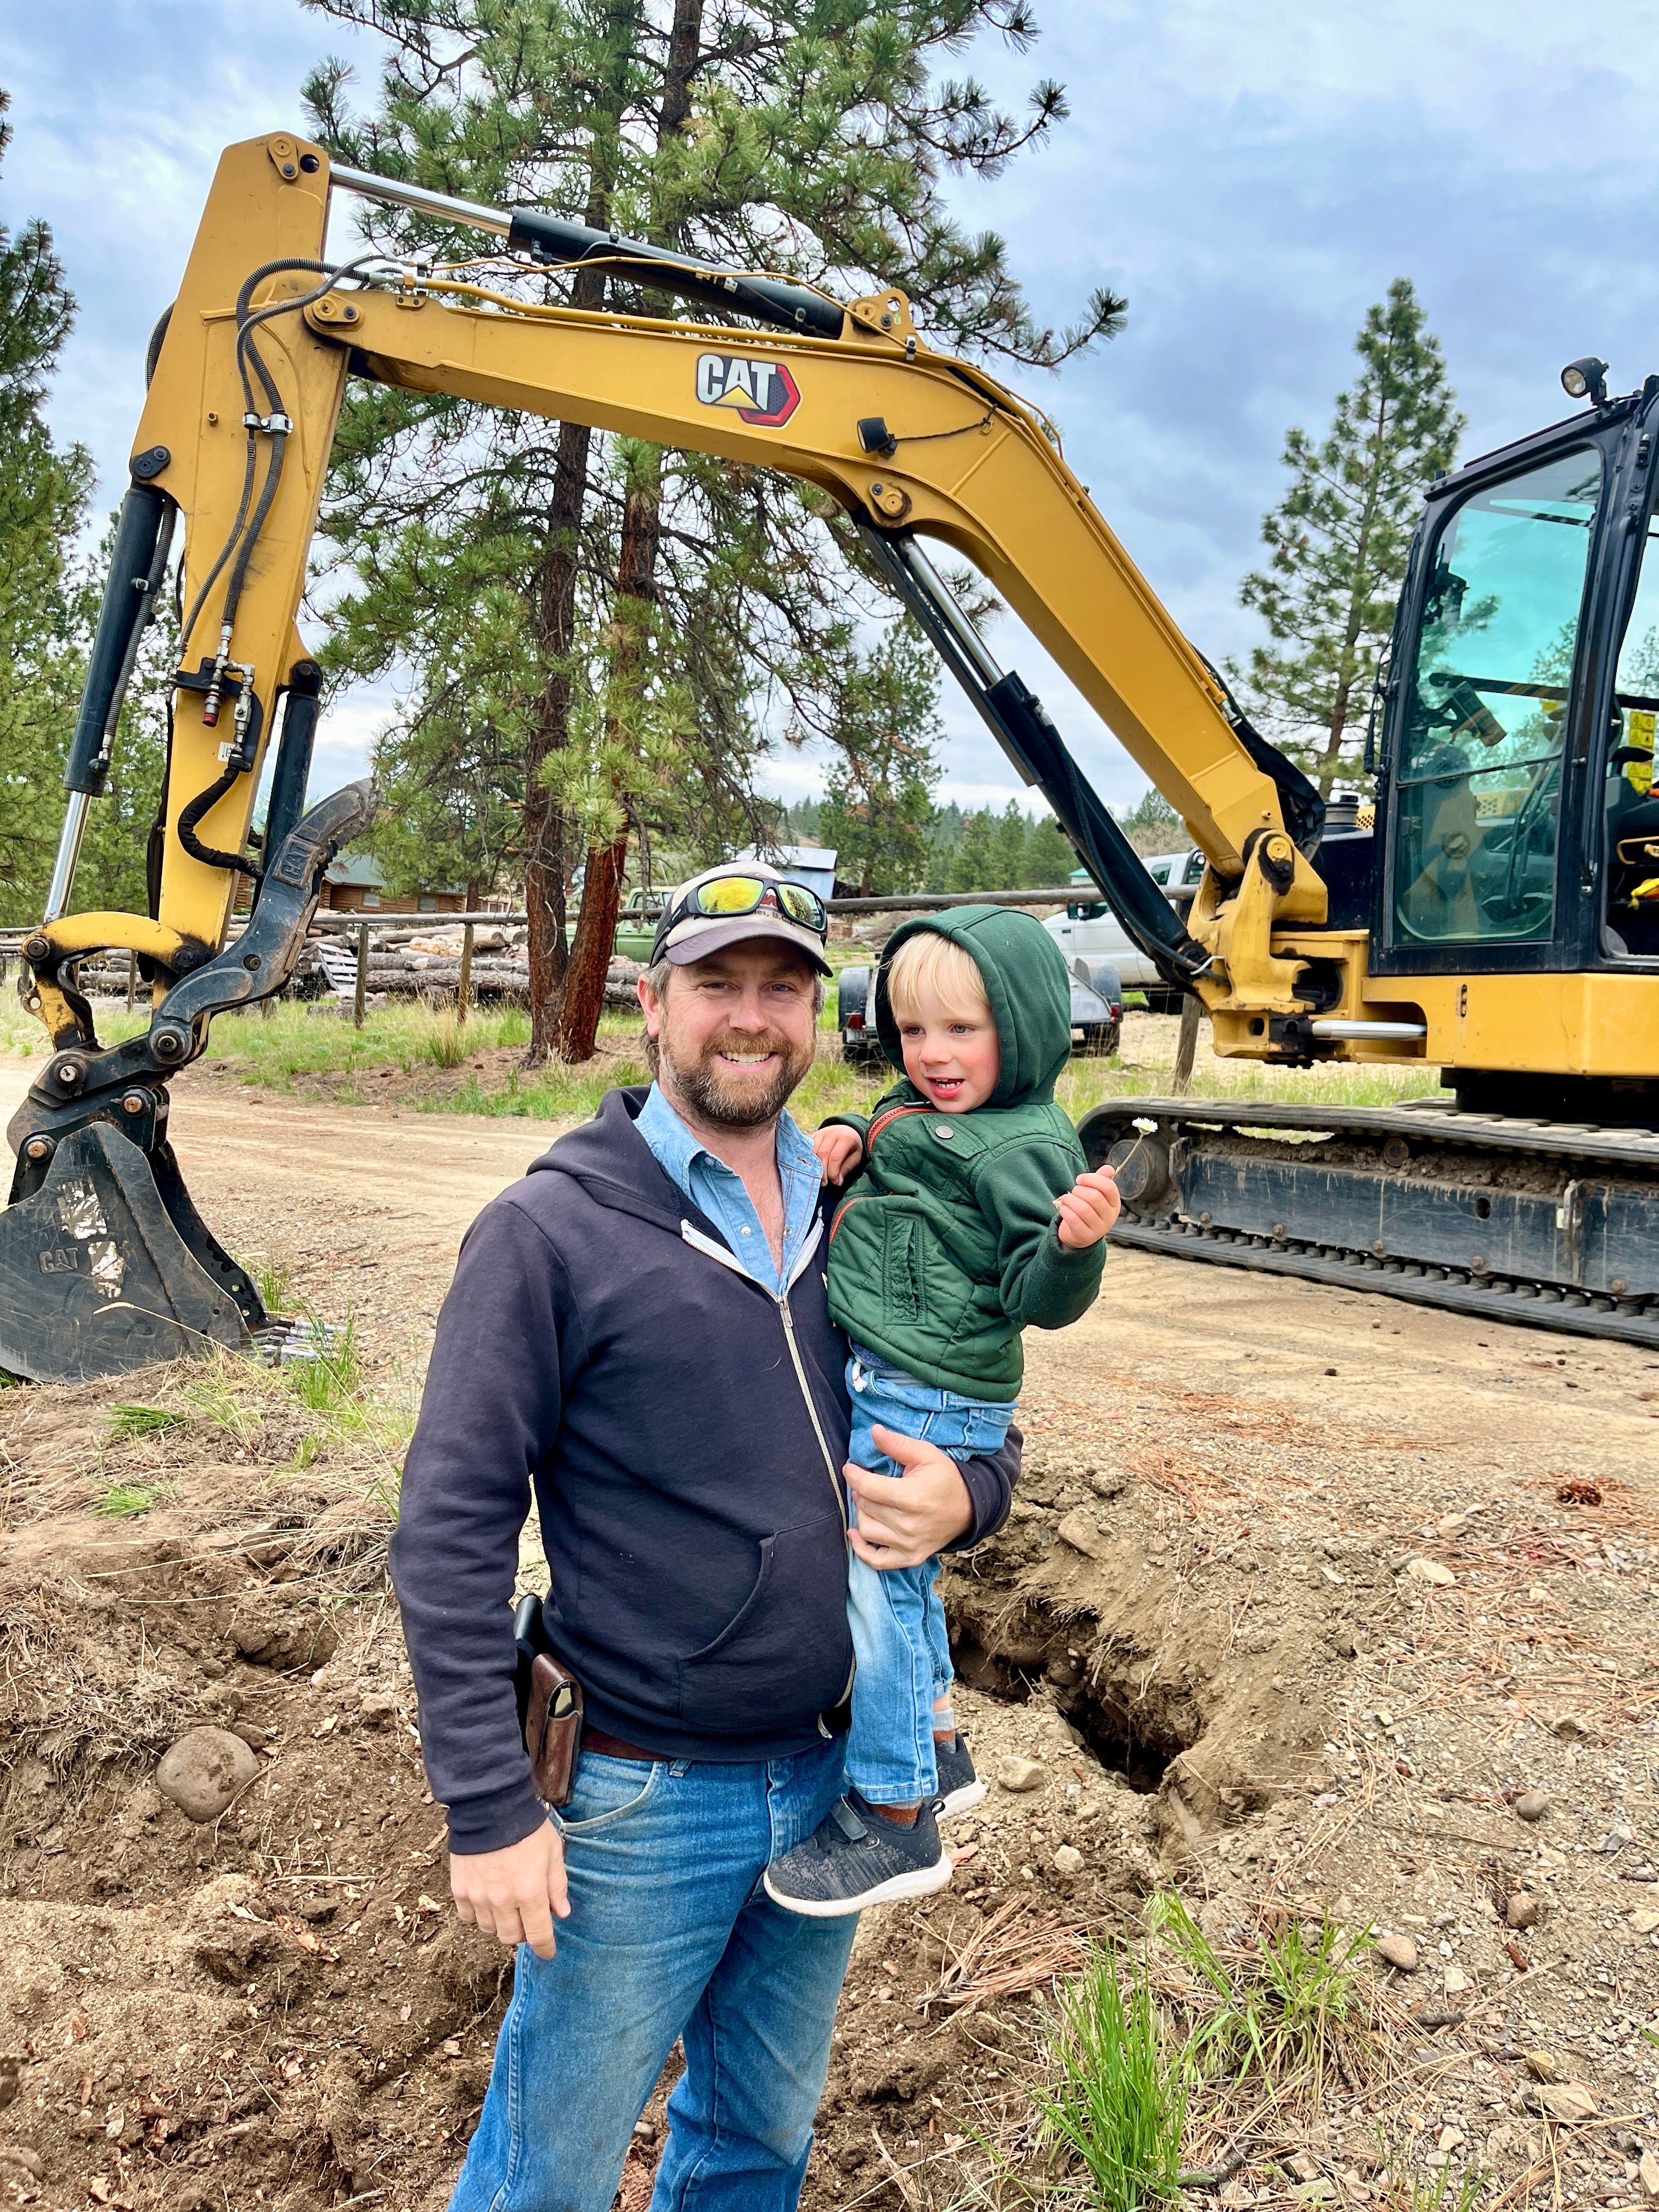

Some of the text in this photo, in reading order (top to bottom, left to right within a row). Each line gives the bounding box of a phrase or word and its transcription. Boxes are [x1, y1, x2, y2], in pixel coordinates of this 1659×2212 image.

[697, 354, 776, 411] CAT
[281, 842, 312, 882] CAT
[39, 1246, 78, 1273] CAT
